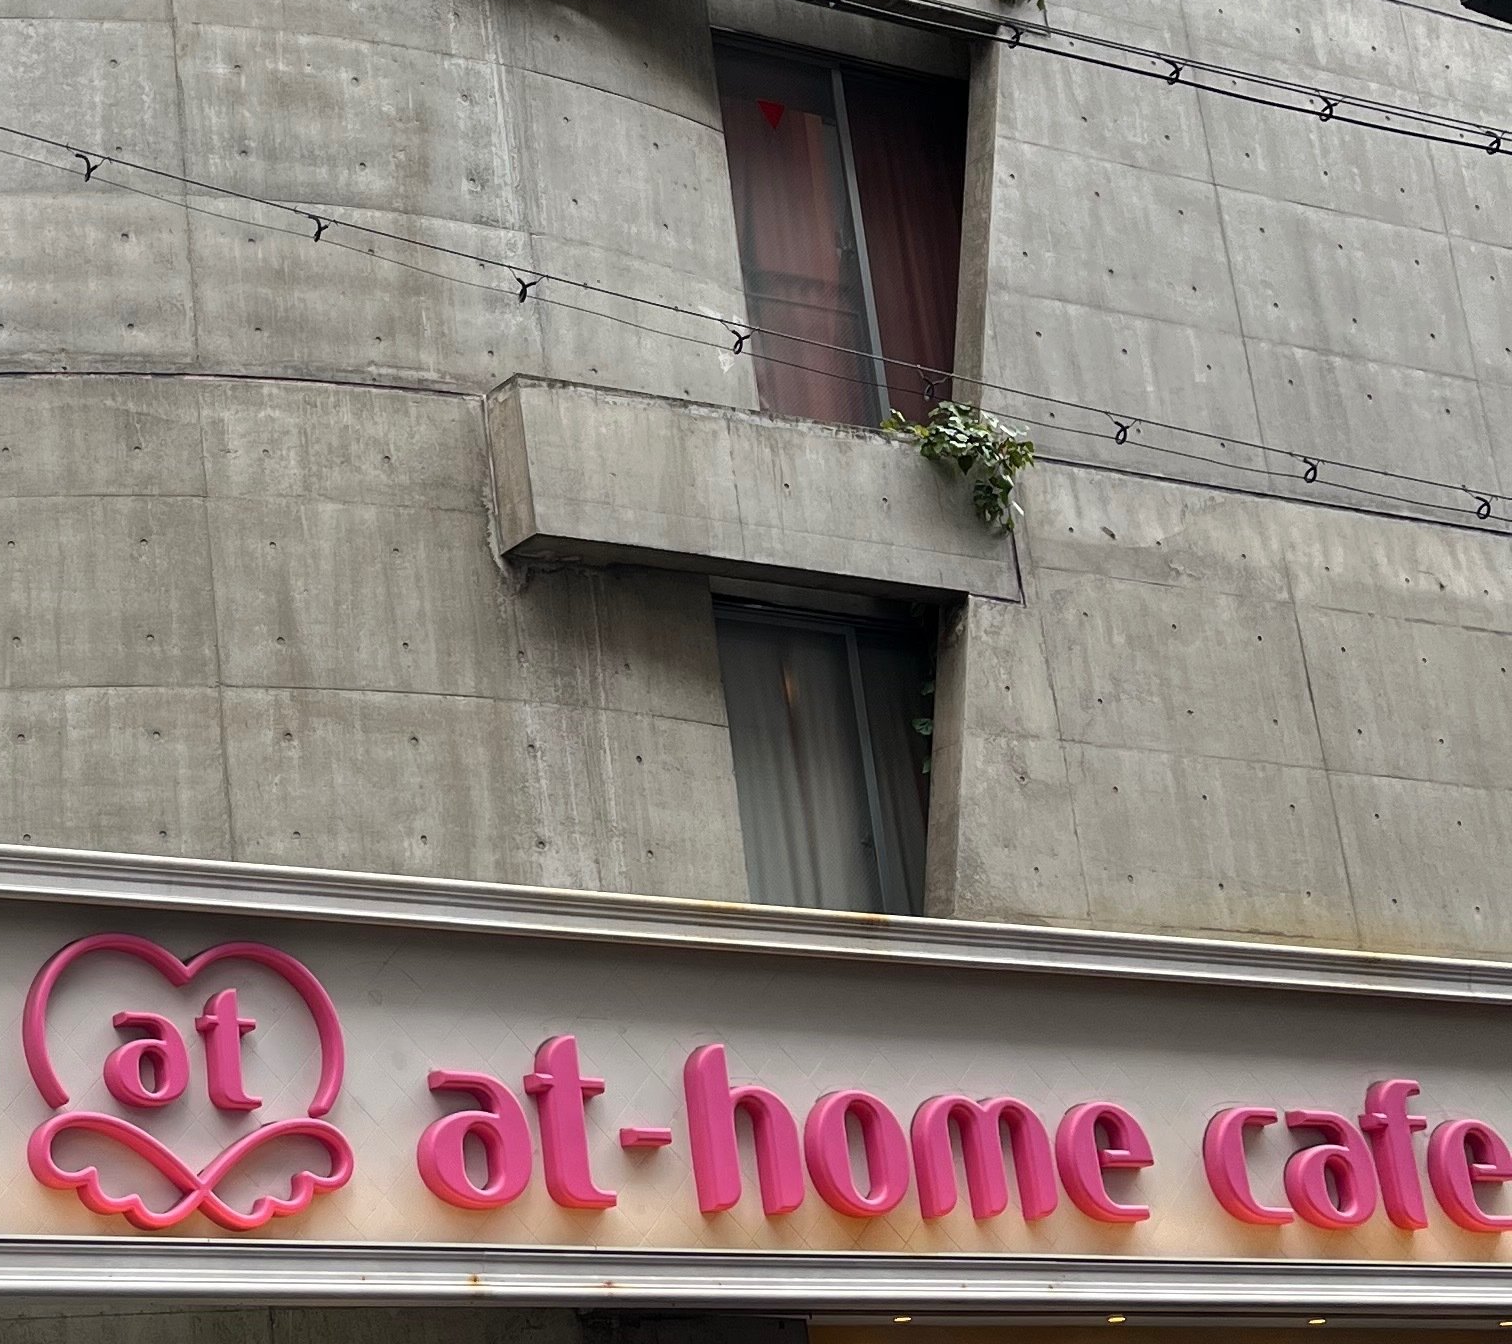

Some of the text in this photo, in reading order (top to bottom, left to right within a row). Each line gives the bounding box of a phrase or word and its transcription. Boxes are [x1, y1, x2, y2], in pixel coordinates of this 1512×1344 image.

[103, 987, 263, 1112] at
[416, 1033, 1512, 1233] at-home cafe
